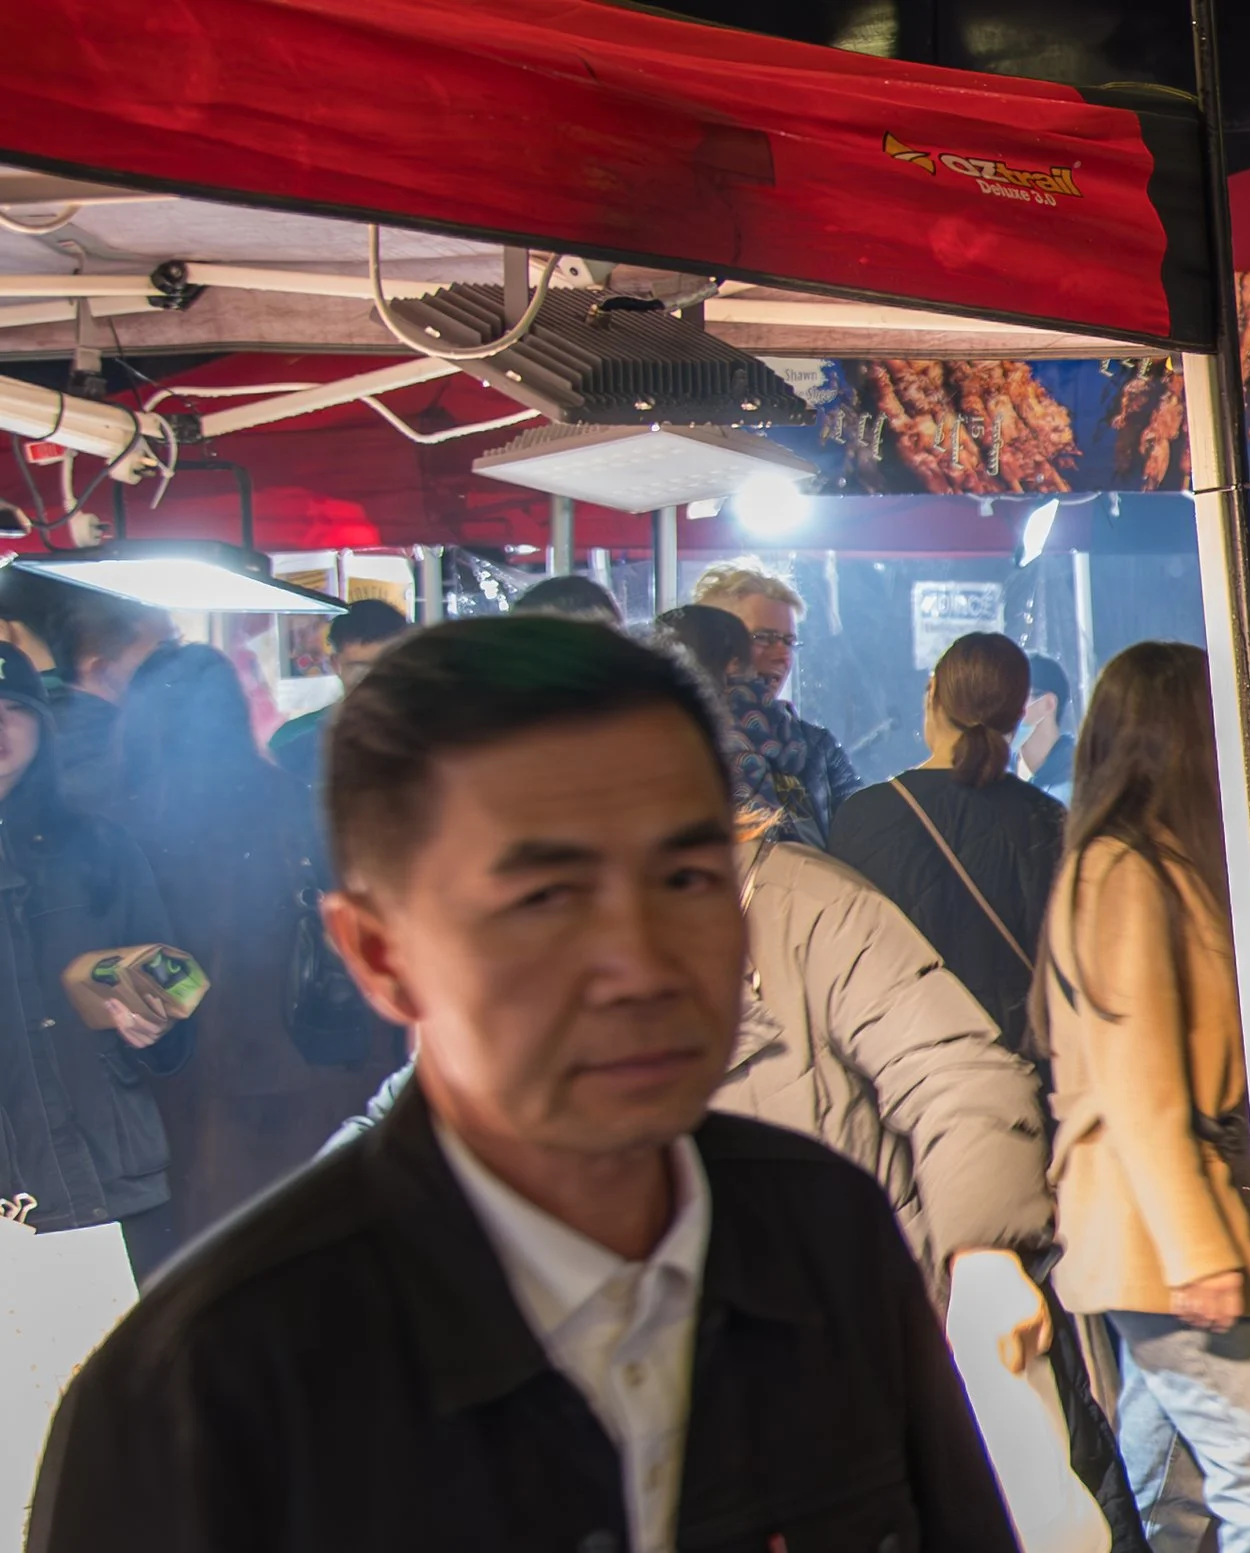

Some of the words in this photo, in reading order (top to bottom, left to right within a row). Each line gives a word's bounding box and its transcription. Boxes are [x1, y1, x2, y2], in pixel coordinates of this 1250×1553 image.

[976, 178, 1031, 202] Deluxe
[1031, 188, 1057, 207] 3.0
[784, 368, 818, 382] Shawn
